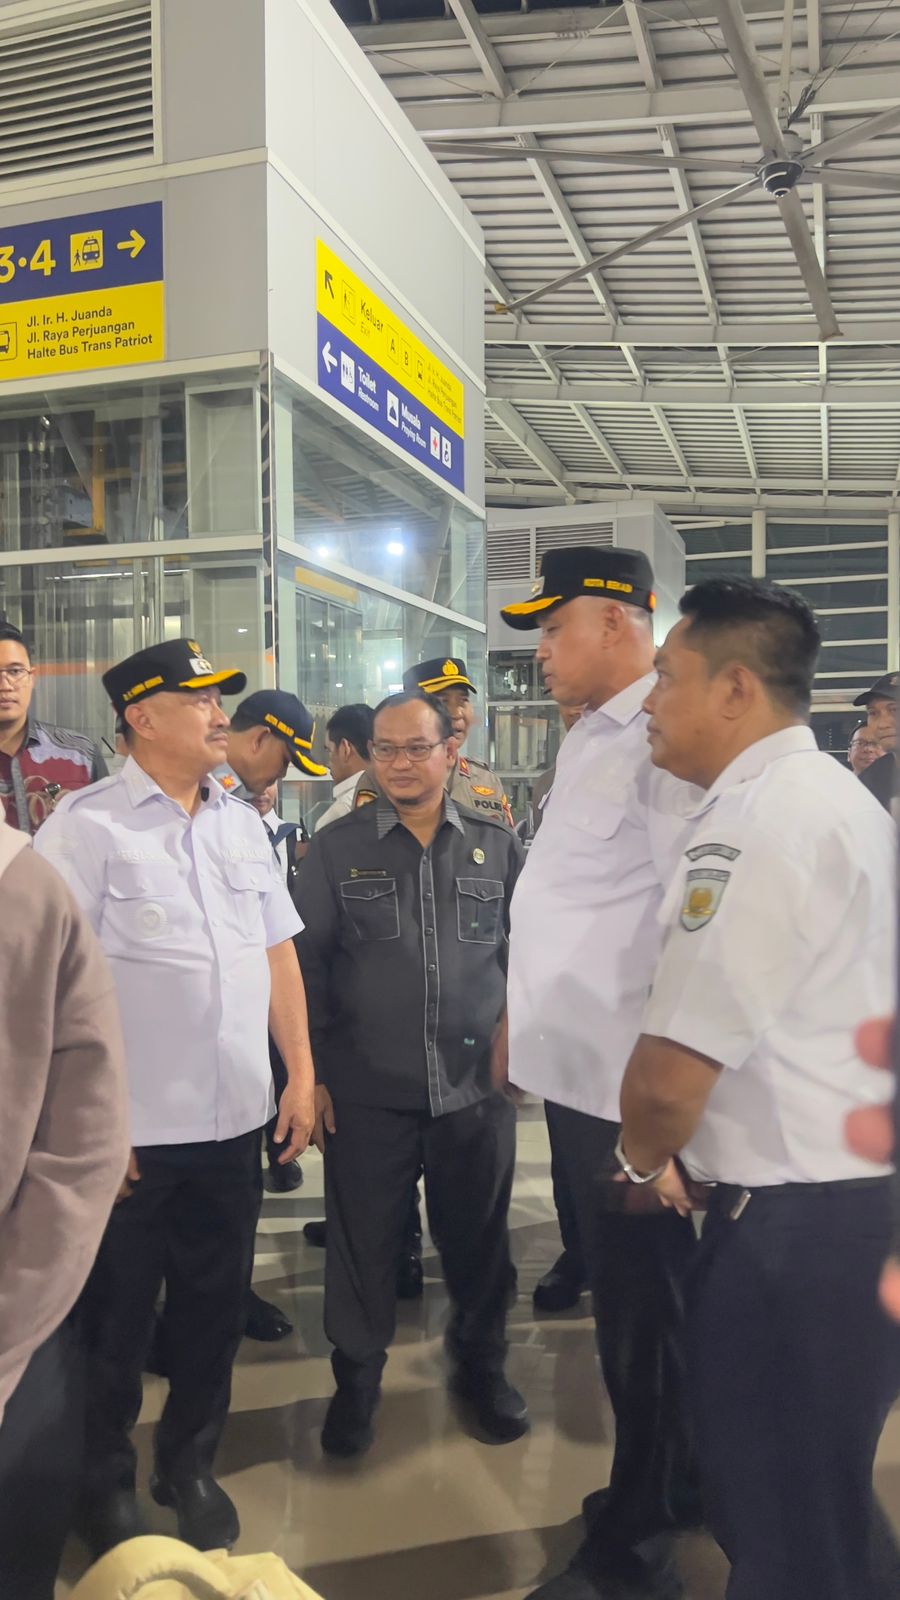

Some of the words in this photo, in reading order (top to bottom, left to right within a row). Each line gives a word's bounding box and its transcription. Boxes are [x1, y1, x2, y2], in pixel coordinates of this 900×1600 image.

[27, 316, 39, 328] Jl.
[43, 315, 53, 325] Ir.
[56, 312, 68, 323] H.
[71, 306, 112, 321] Juanda
[361, 299, 384, 333] Keluar
[27, 332, 40, 344] Jl.
[43, 330, 69, 343] Raya
[72, 321, 135, 338] Perjuangan
[27, 347, 56, 360] Halte
[59, 344, 78, 356] Bus
[81, 340, 112, 353] Trans
[115, 334, 153, 348] Patriot
[390, 338, 396, 353] A
[404, 352, 409, 366] B
[358, 366, 376, 394] Toilet
[401, 403, 421, 430] Musala
[358, 386, 379, 412] Restroom
[401, 421, 416, 443] Praying
